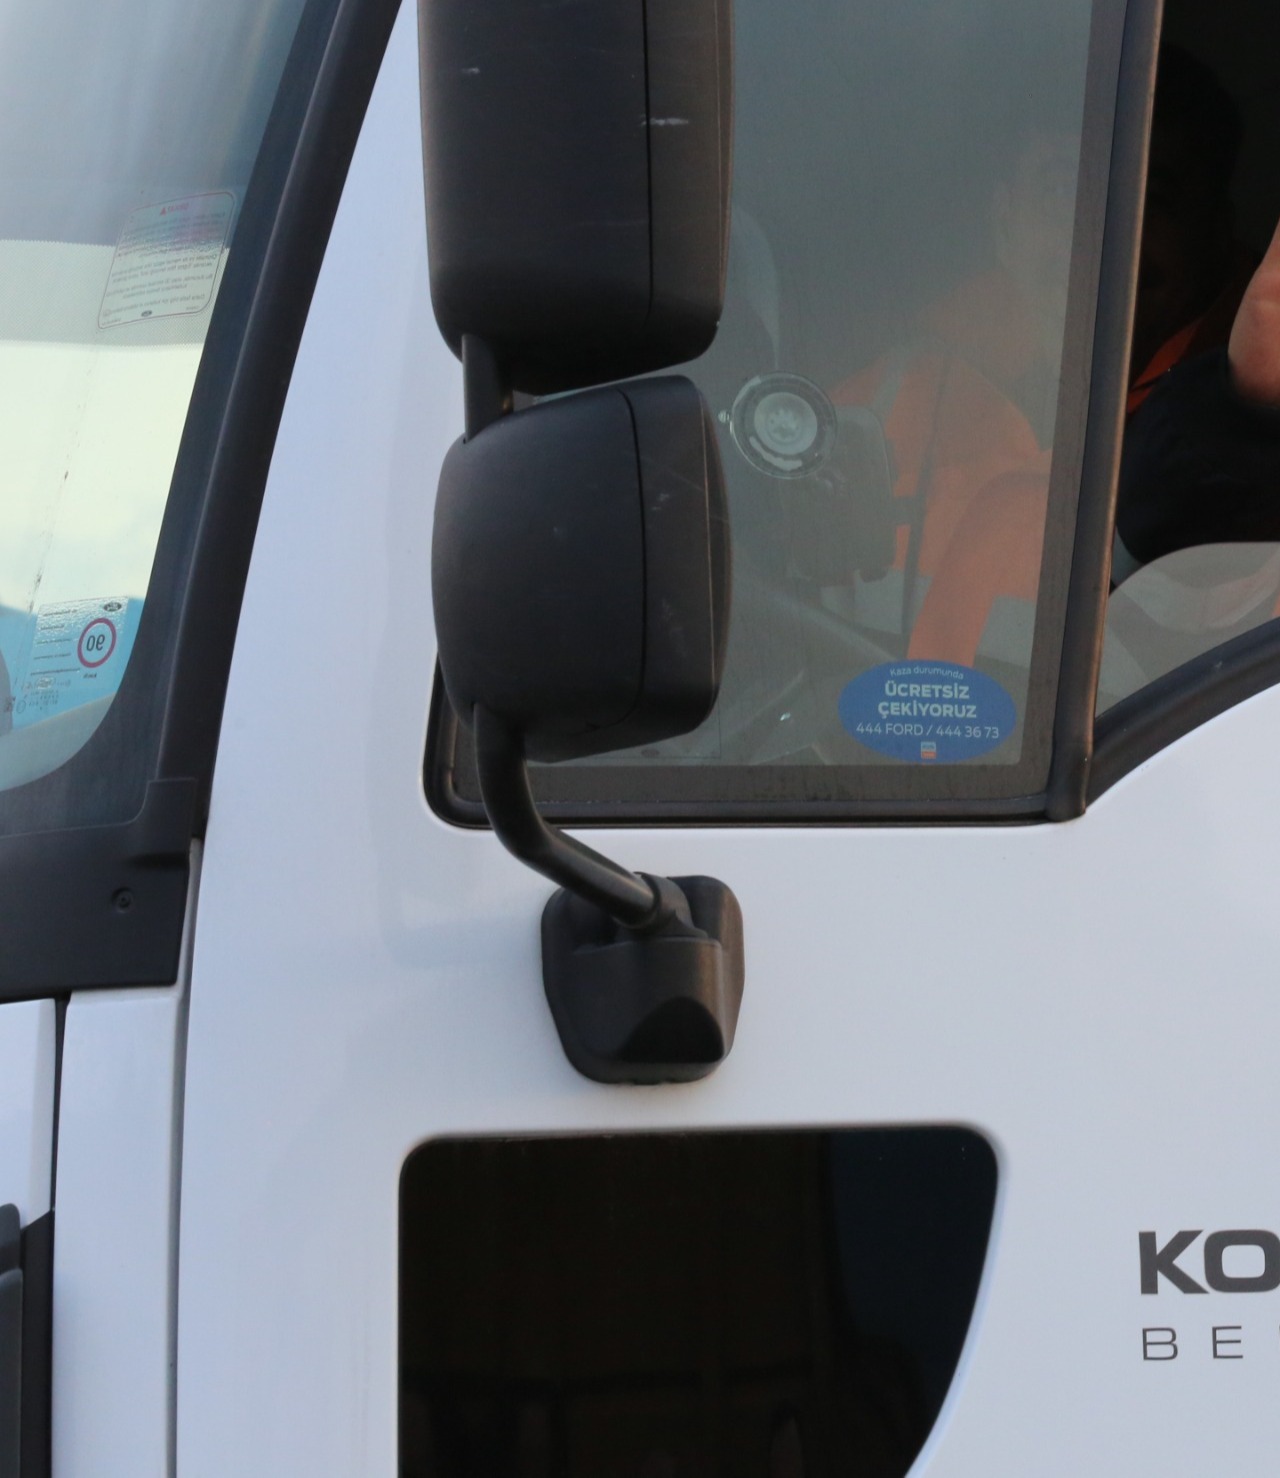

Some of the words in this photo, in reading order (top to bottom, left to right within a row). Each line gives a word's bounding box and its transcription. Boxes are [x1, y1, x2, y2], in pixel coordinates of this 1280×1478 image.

[889, 667, 912, 677] Kaza
[913, 665, 964, 680] durumunda
[885, 680, 970, 699] ÜCRETSİZ
[878, 699, 977, 720] ÇEKİYORUZ
[856, 722, 882, 735] 444
[886, 723, 924, 736] FORD
[936, 725, 961, 738] 444
[964, 726, 982, 738] 36
[984, 726, 1000, 739] 73
